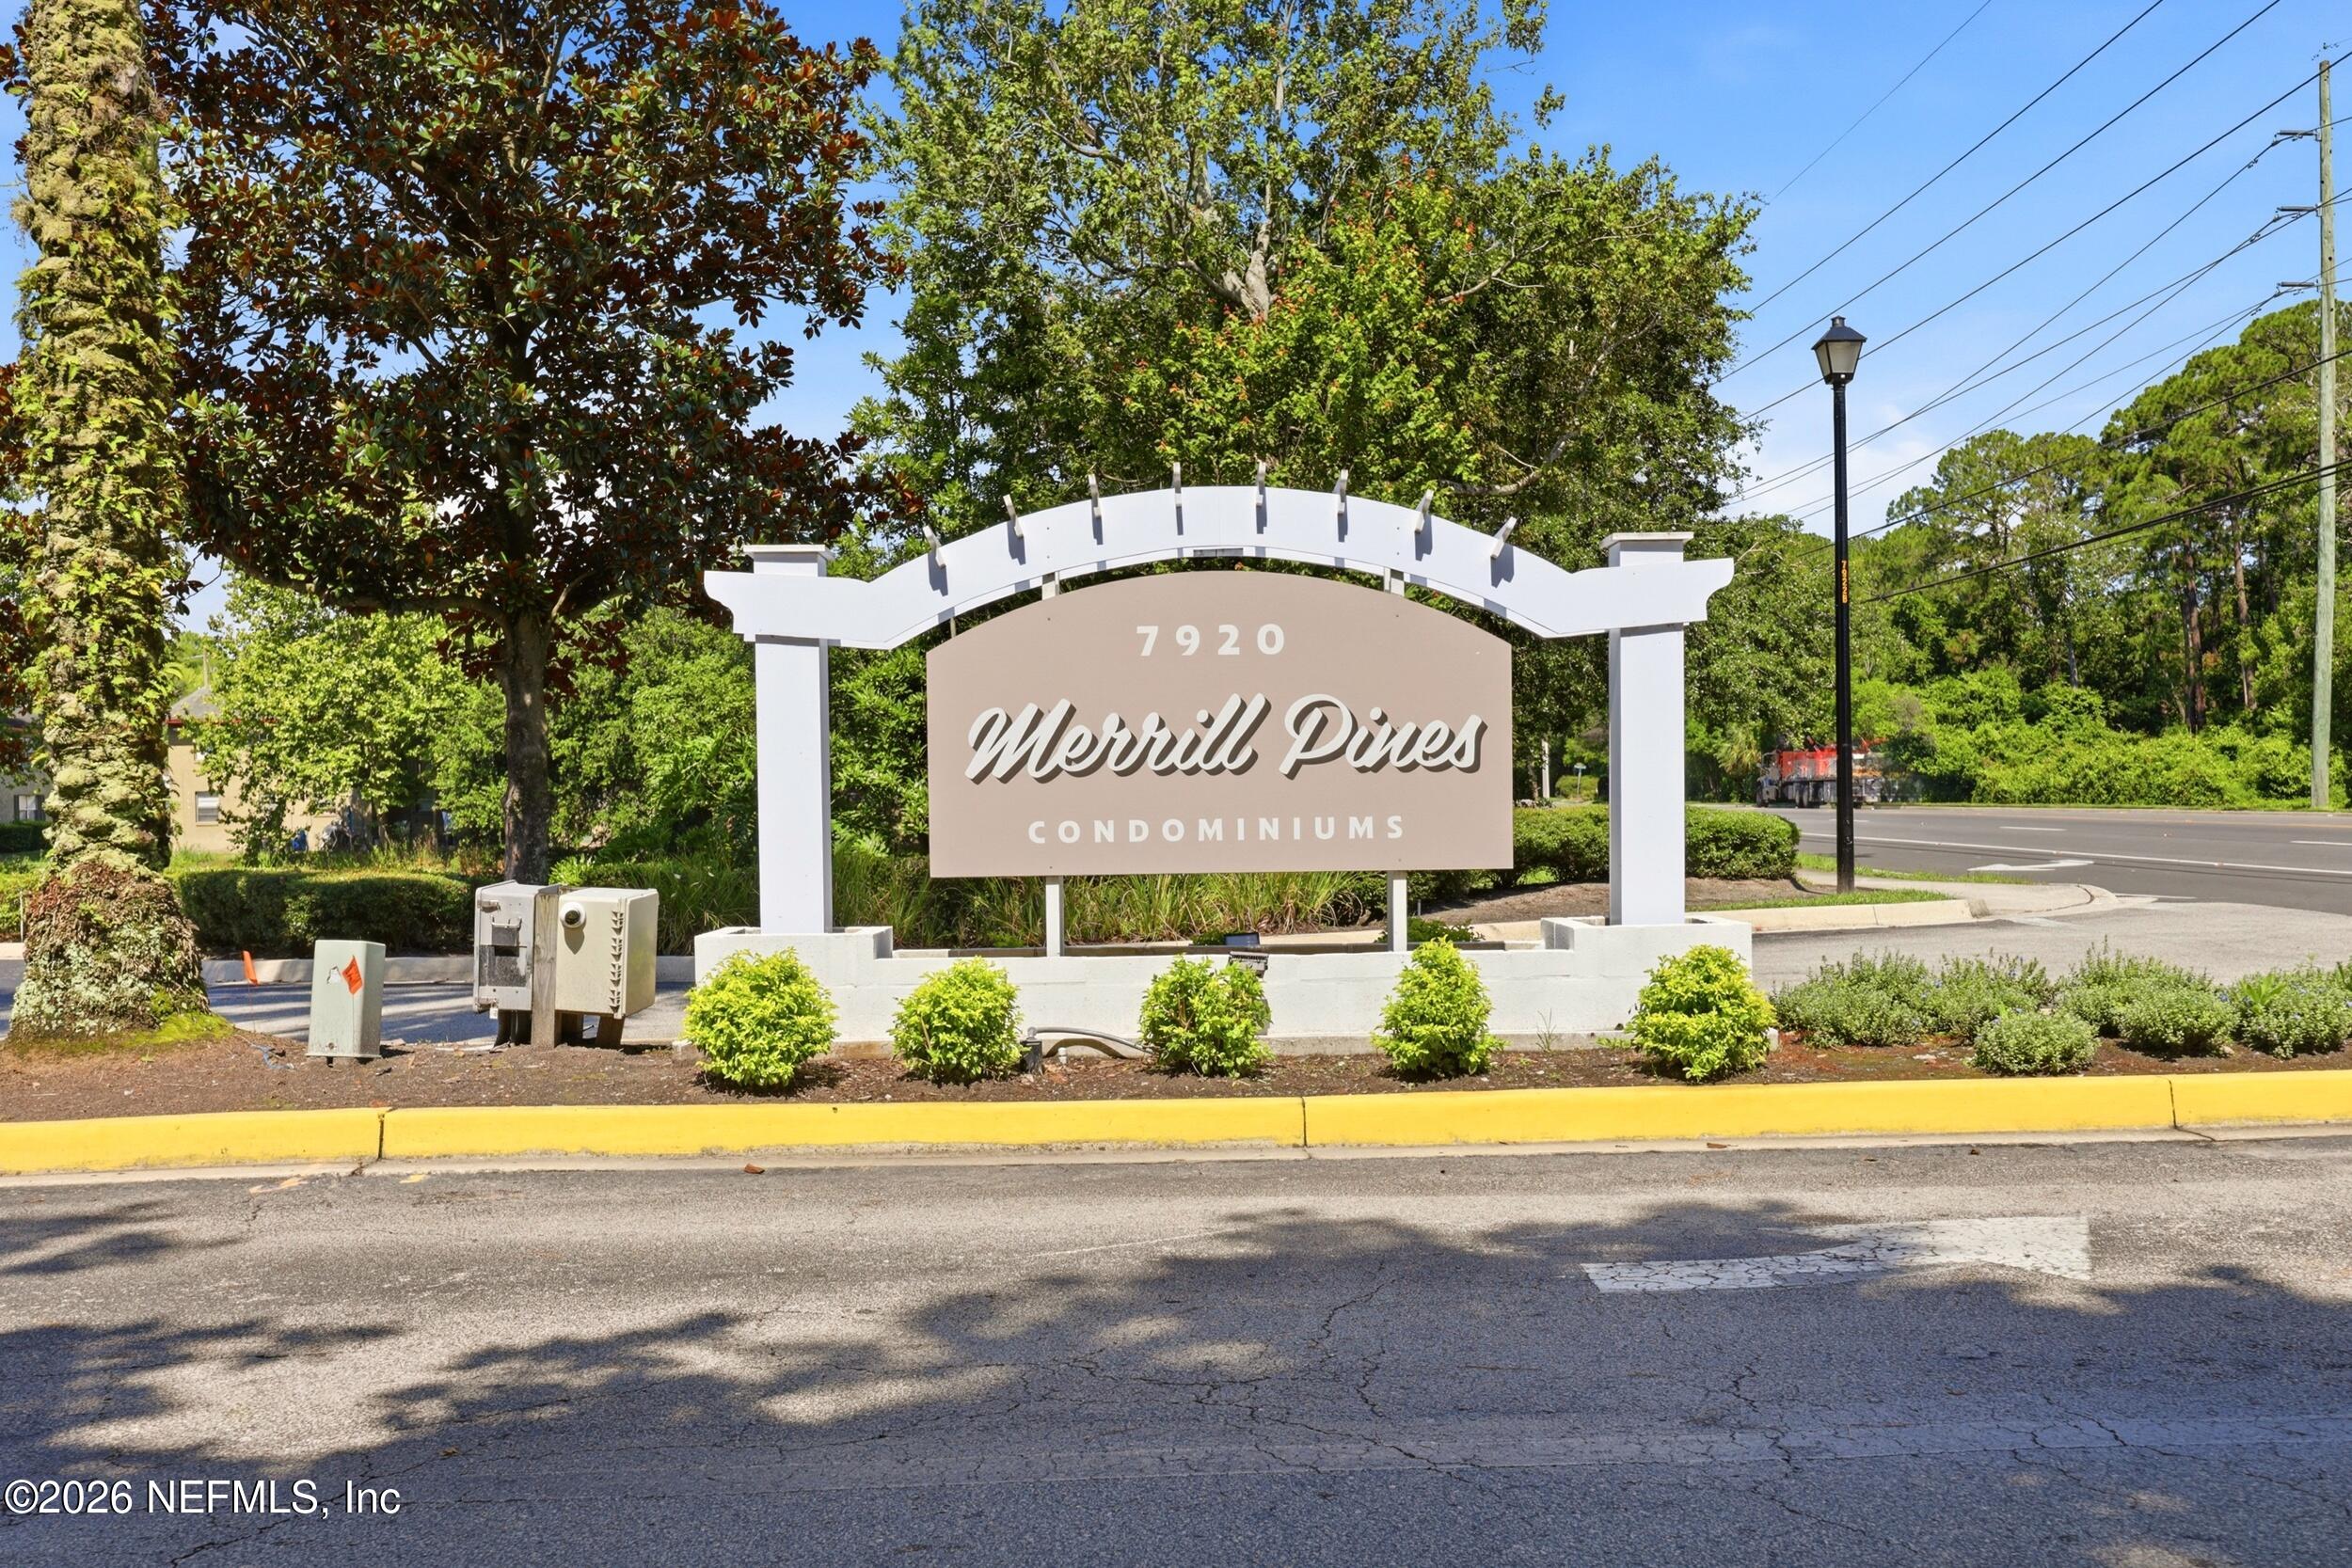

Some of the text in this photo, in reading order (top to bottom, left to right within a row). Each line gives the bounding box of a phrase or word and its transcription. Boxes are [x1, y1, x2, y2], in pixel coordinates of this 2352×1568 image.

[1136, 623, 1285, 657] 7920
[964, 691, 1487, 784] Merrill Pines
[1028, 815, 1405, 846] CONDOMINIUMS
